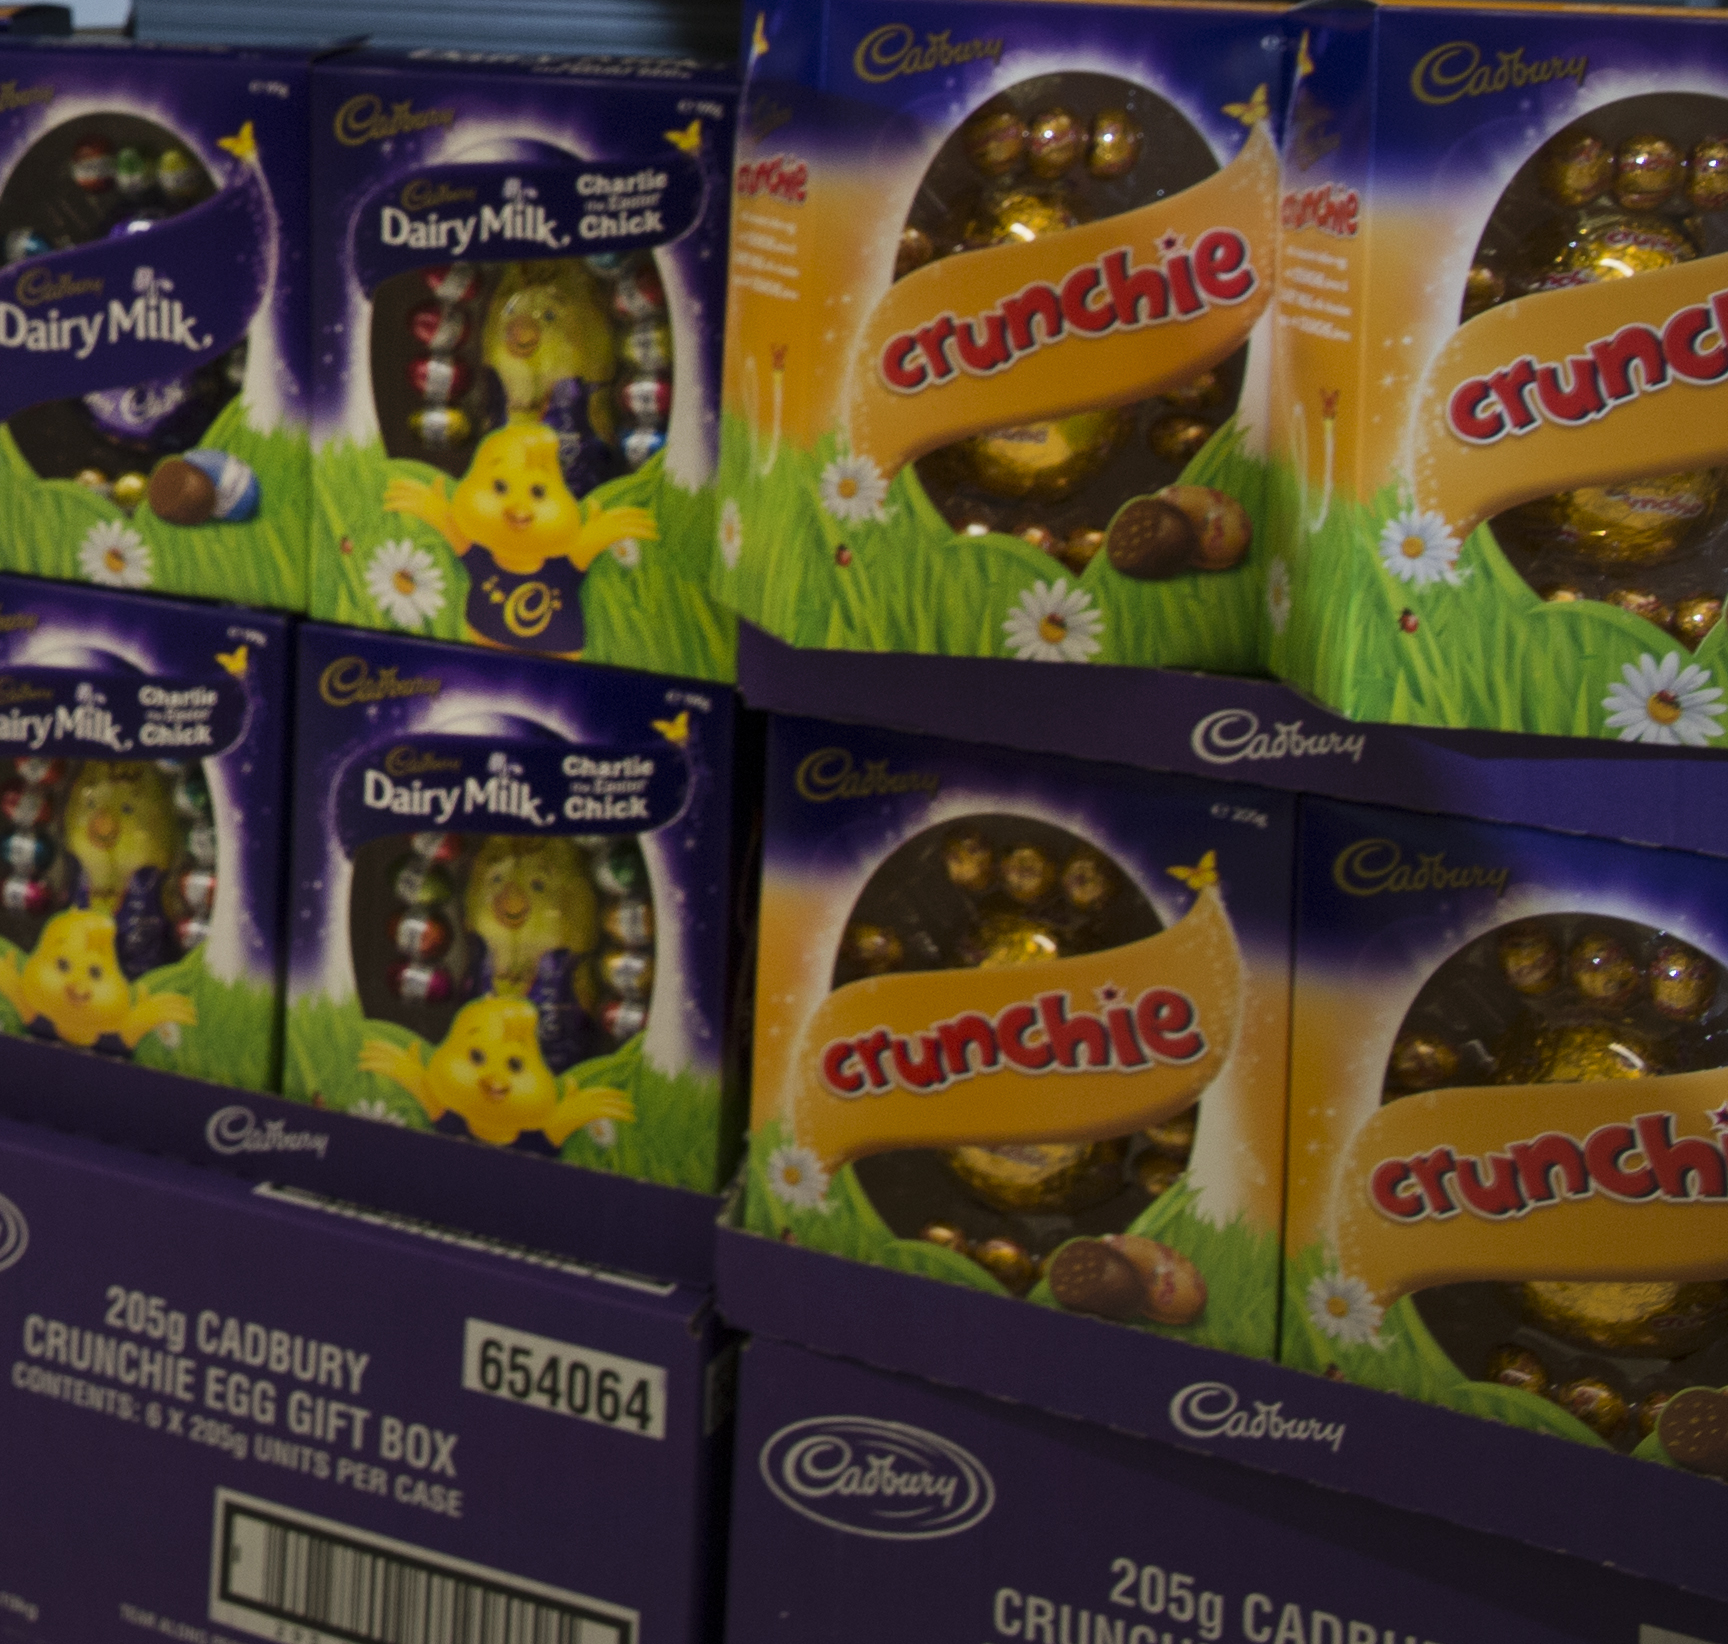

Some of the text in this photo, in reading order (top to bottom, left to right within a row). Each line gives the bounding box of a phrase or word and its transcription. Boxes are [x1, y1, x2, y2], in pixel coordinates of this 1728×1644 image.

[853, 23, 1005, 84] Cadbury
[1410, 40, 1588, 106] Cadbury
[334, 93, 456, 146] Cadbury
[575, 171, 668, 198] Charlie
[380, 203, 558, 256] Dairy Milk
[578, 211, 665, 239] Chick
[16, 268, 107, 307] Cadbury
[879, 226, 1257, 396] crunchie
[108, 296, 208, 349] Milk
[1449, 288, 1728, 446] crunc
[137, 685, 219, 708] Charlie
[319, 656, 442, 707] Cadbury
[54, 701, 124, 749] Milk
[138, 723, 214, 747] Chick
[1191, 708, 1367, 763] Cadbury
[560, 755, 655, 779] Charlie
[795, 747, 941, 803] Cadbury
[363, 768, 545, 826] Dairy Milk
[562, 795, 649, 820] Chick
[1333, 838, 1511, 897] Cadbury
[821, 986, 1210, 1098] crunchie
[206, 1104, 329, 1158] Cadbury
[1369, 1106, 1728, 1222] crunch
[104, 1284, 372, 1396] 205g CADBURY
[22, 1312, 460, 1478] CRUNCHIE EGG GIFT BOX
[477, 1337, 654, 1432] 654064
[11, 1359, 143, 1424] CONTENTS:
[145, 1400, 163, 1431] 6
[188, 1413, 249, 1460] 205g
[254, 1427, 332, 1481] UNITS
[335, 1453, 389, 1498] PER
[395, 1474, 466, 1519] CASE
[1169, 1382, 1346, 1454] Cadbury
[783, 1435, 959, 1507] Cadbury
[1108, 1556, 1227, 1636] 205g
